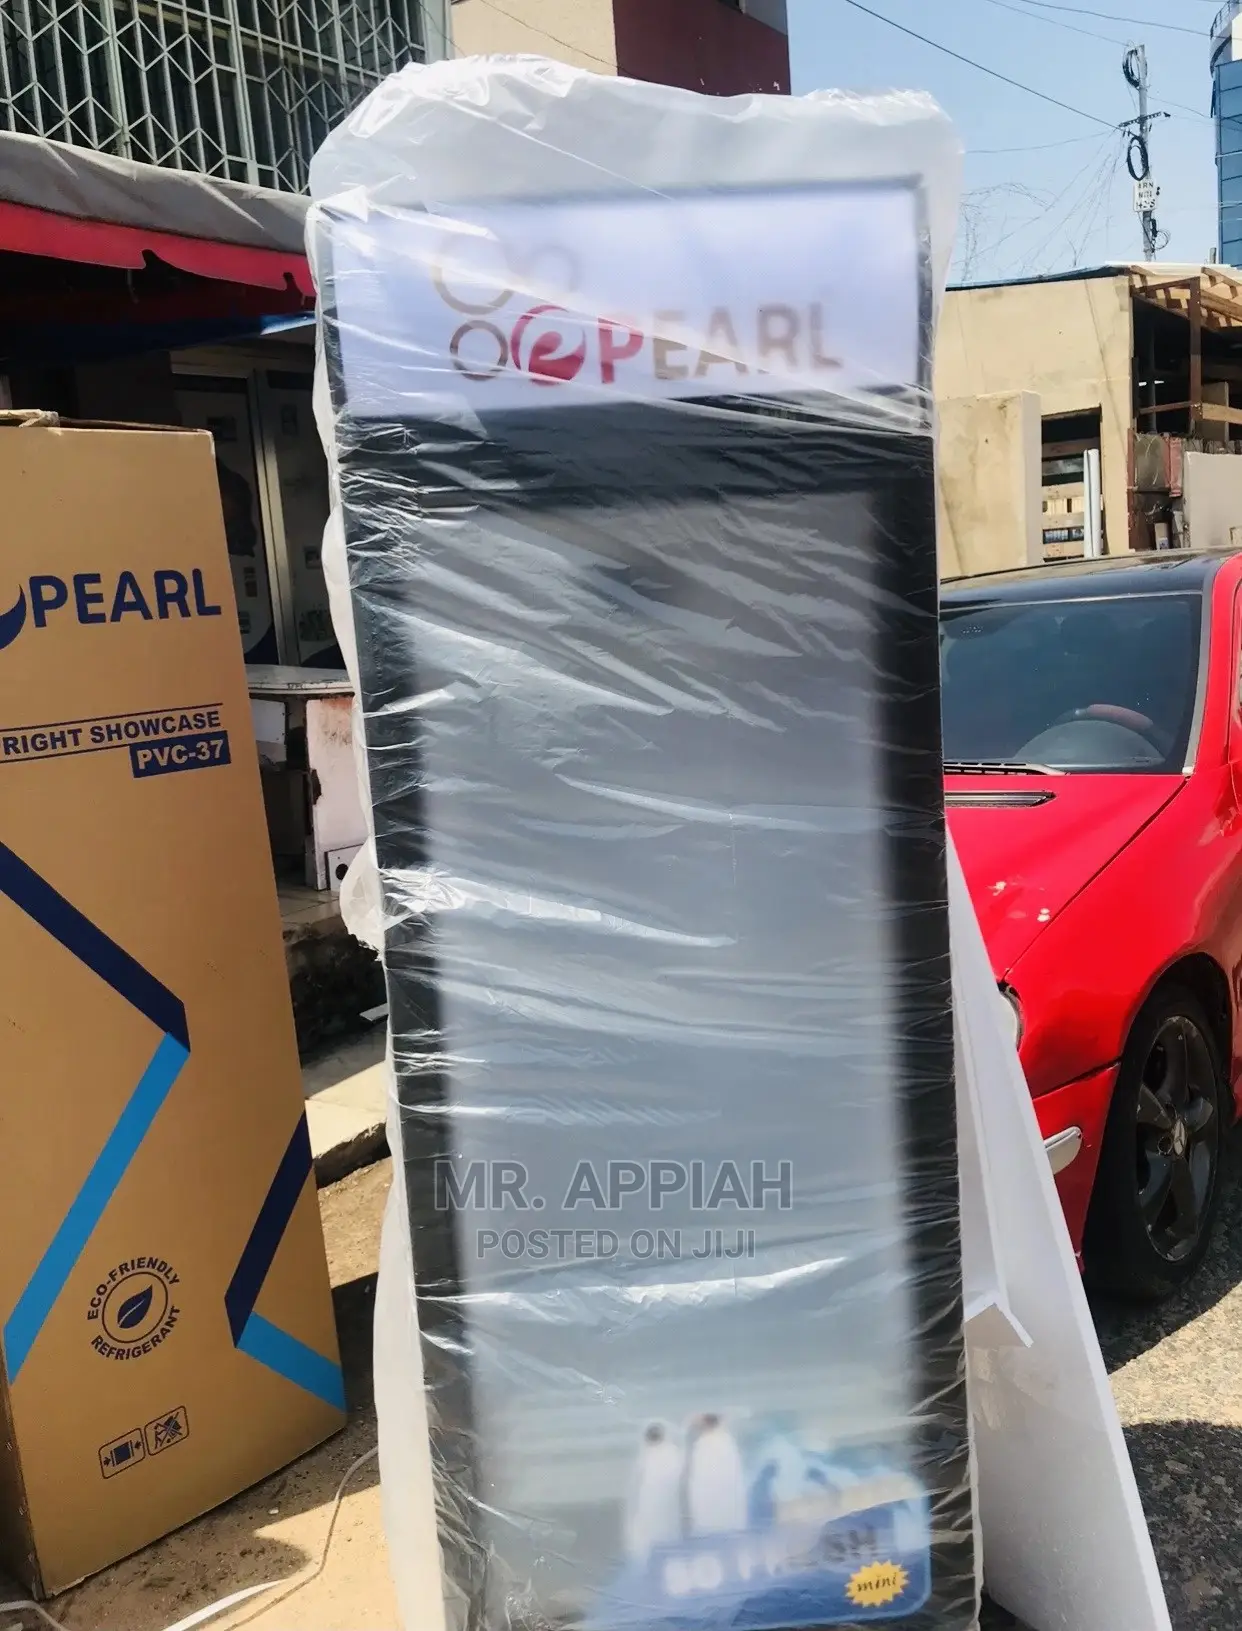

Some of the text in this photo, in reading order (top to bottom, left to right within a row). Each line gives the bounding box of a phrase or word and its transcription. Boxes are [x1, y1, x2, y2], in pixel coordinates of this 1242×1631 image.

[597, 302, 843, 384] PEARL
[28, 568, 222, 628] PEARL
[89, 711, 221, 744] SHOWCASE
[136, 739, 224, 770] PVC-37
[87, 1256, 181, 1321] ECO-FRIENDLY
[90, 1305, 181, 1360] REFRIGERANT
[857, 1571, 897, 1592] mini
